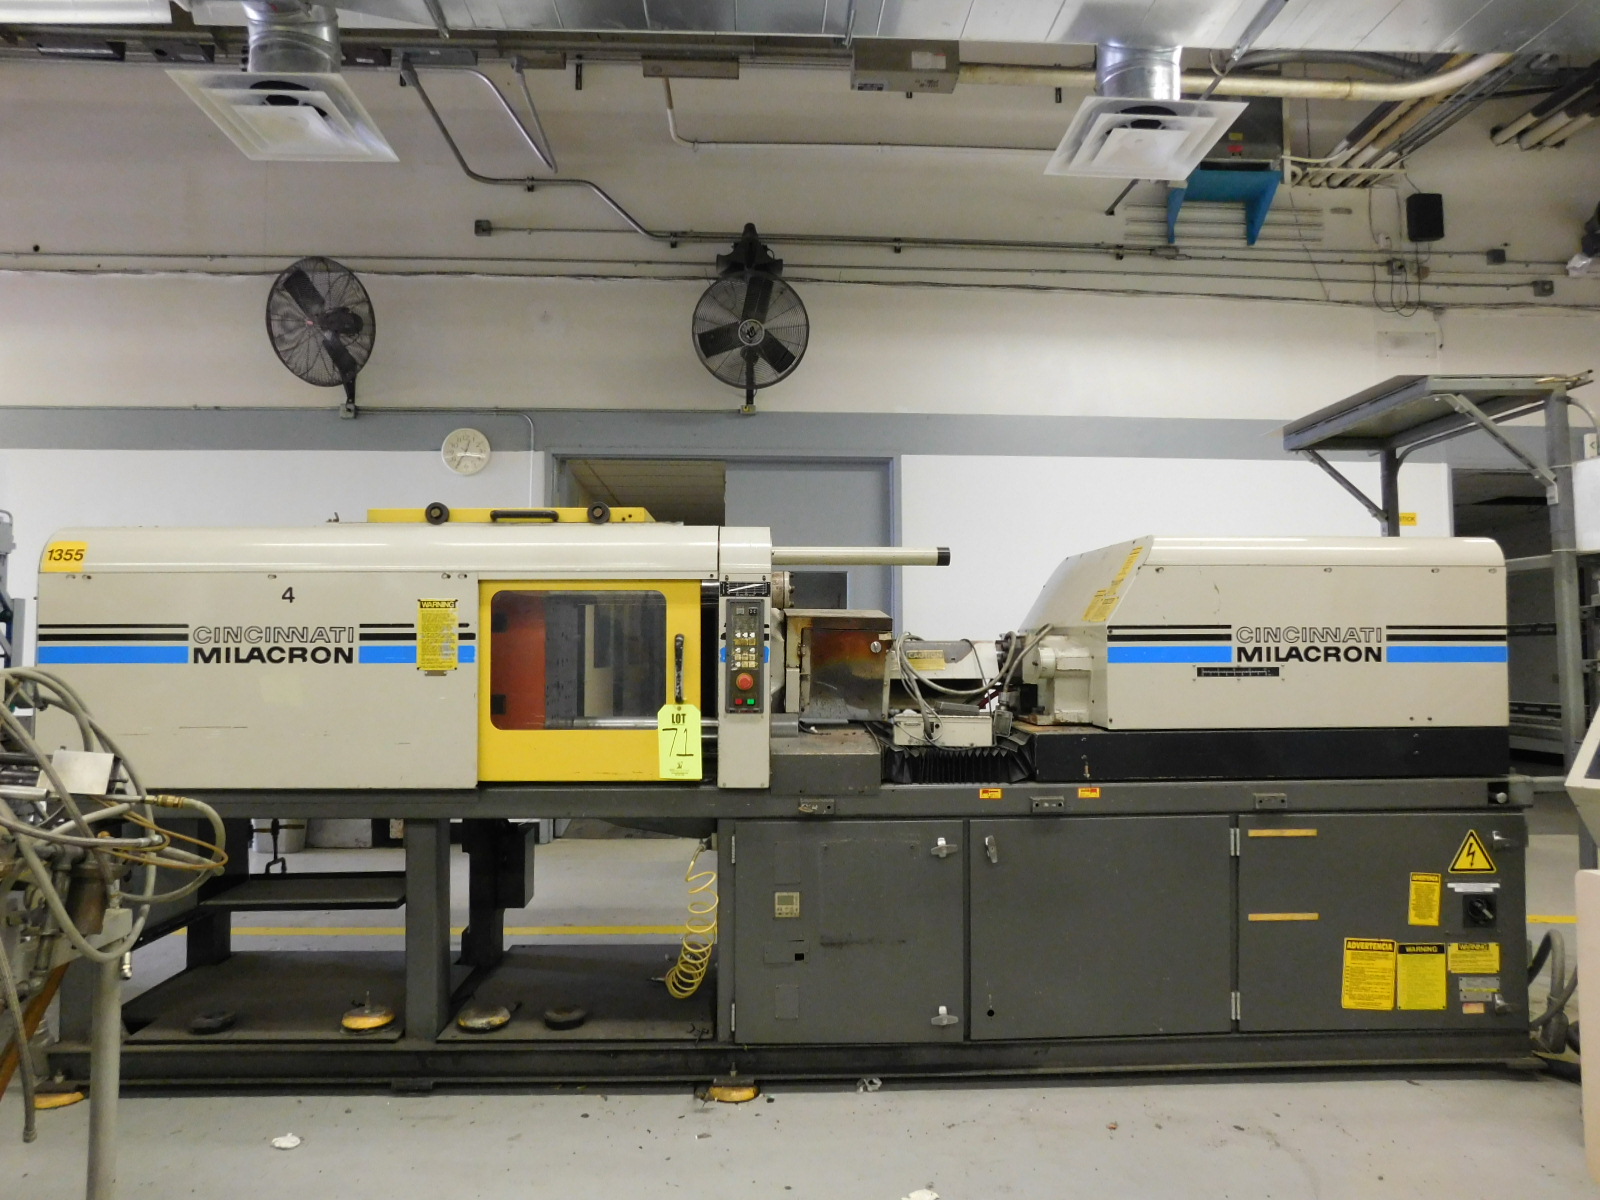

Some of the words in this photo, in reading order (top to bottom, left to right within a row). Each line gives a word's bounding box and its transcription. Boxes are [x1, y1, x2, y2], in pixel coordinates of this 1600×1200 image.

[47, 549, 85, 561] 1355
[281, 586, 295, 603] 4
[193, 626, 354, 644] CINCINNATI
[1236, 626, 1382, 644] CINCINNATI
[193, 646, 354, 664] MILACRON
[1236, 646, 1382, 663] MILACRON
[671, 713, 686, 724] LOT
[662, 728, 694, 757] 71
[1346, 940, 1393, 951] ADVERTENCIA
[1405, 945, 1438, 953] WARNING
